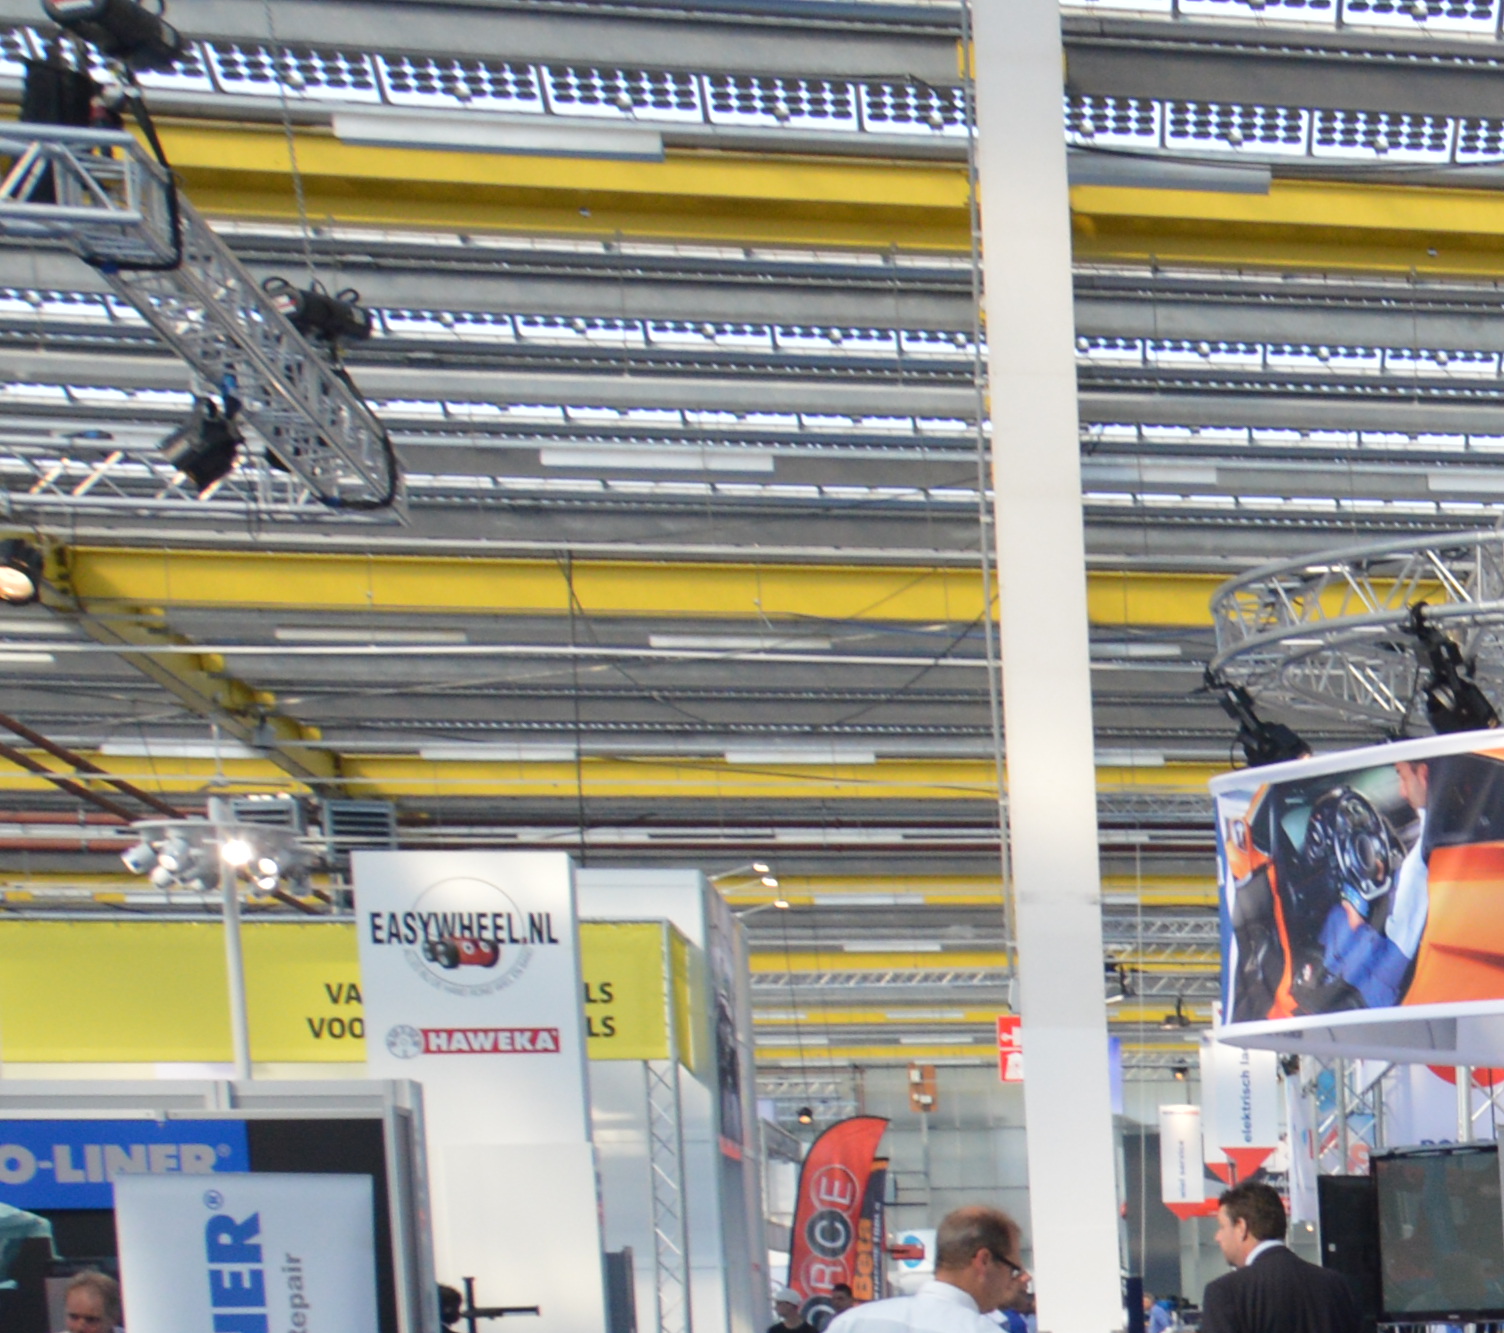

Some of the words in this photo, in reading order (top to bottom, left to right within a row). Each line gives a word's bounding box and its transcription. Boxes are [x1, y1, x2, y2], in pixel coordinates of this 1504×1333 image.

[369, 911, 559, 946] EASYWHEEL.NL
[325, 981, 362, 1004] VA
[307, 1016, 365, 1038] VOO
[427, 1030, 557, 1052] HAWEKA
[1239, 1069, 1252, 1143] elektrisch
